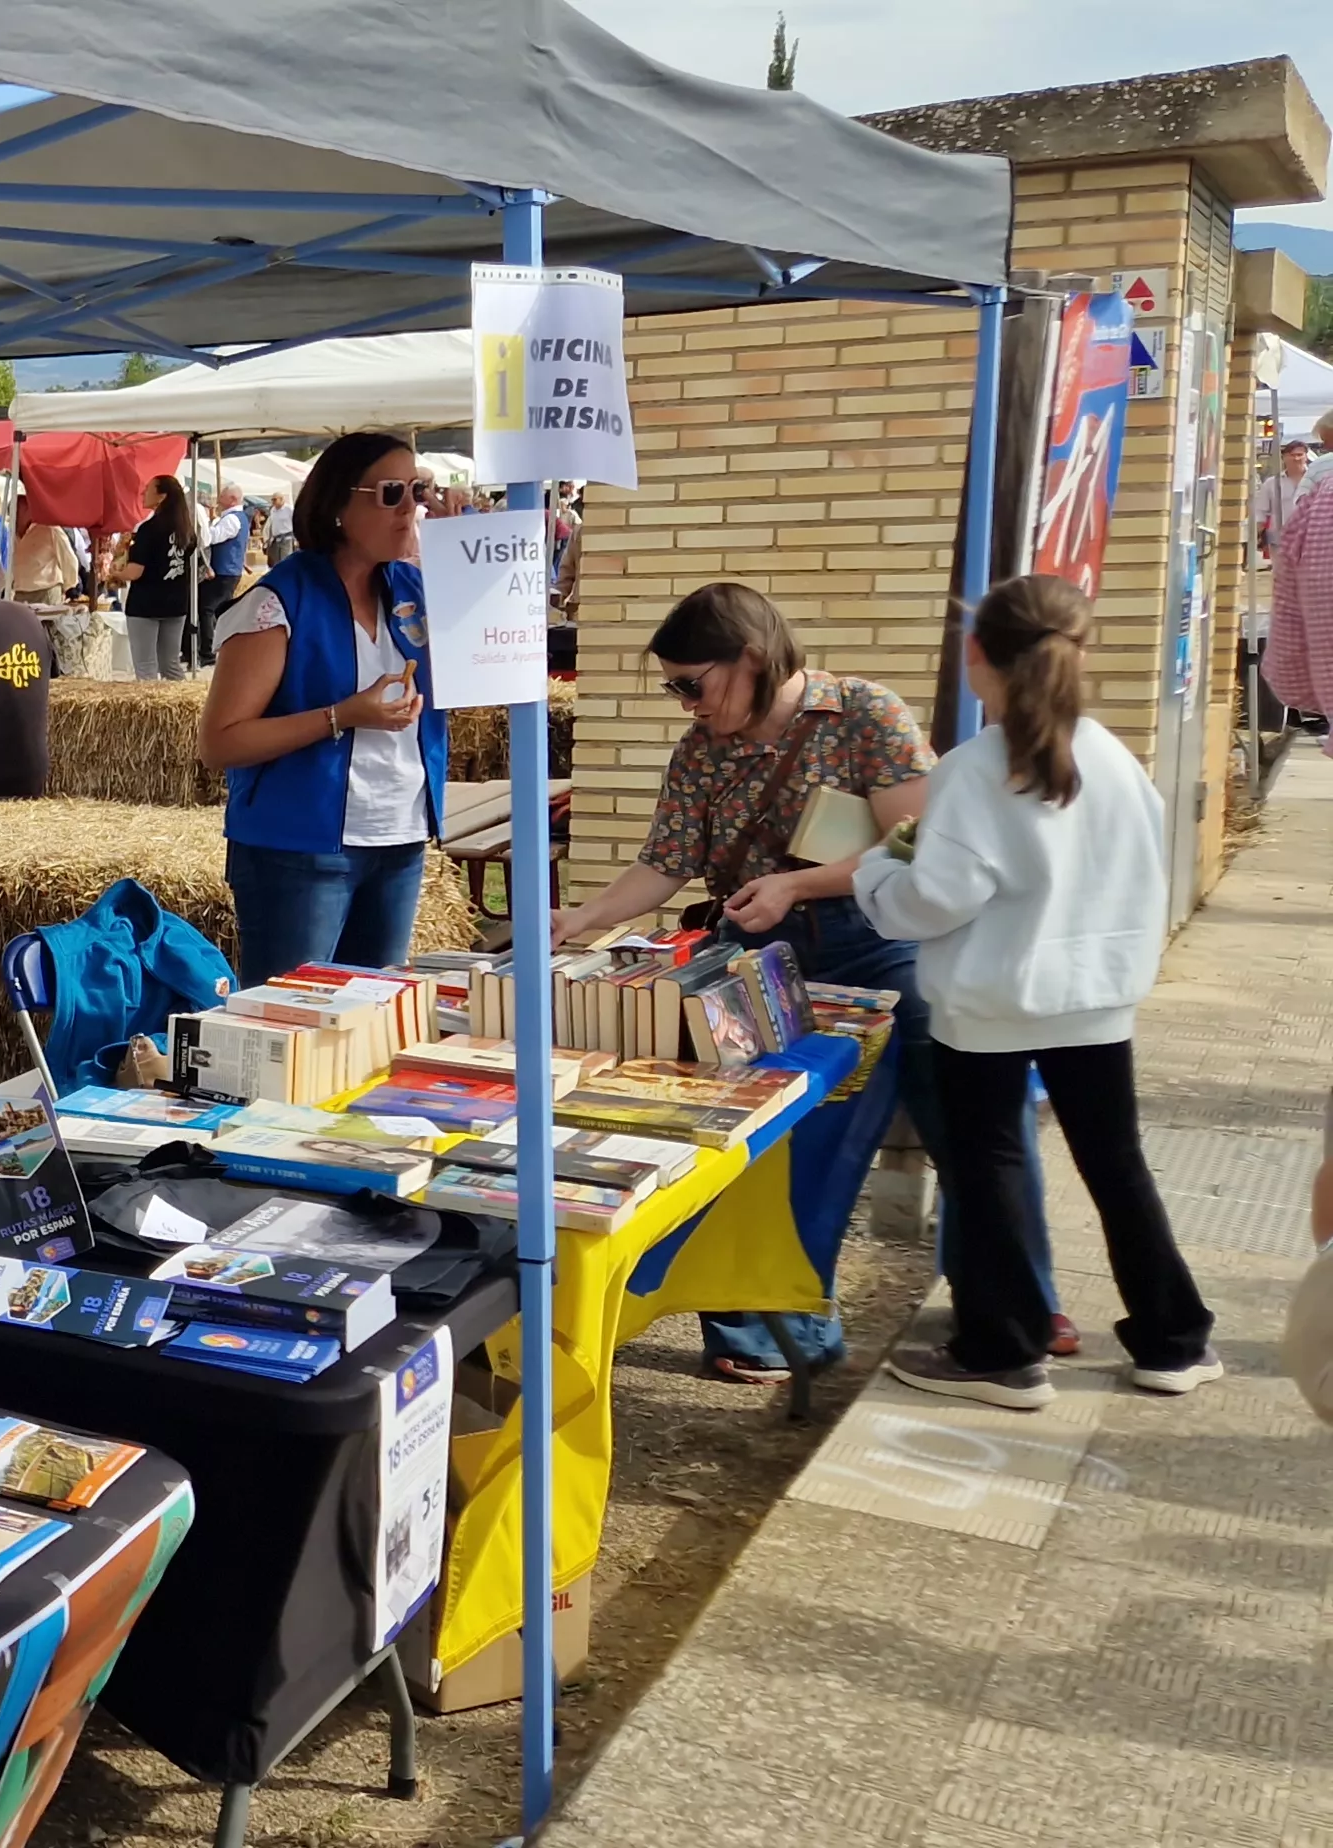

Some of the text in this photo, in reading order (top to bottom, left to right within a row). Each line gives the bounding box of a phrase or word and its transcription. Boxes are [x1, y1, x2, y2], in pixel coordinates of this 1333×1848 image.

[530, 338, 613, 369] OFICINA
[552, 378, 589, 398] DE
[528, 406, 623, 437] TURISMO
[460, 535, 539, 564] Visita
[20, 1186, 52, 1212] 18
[0, 1201, 78, 1239] RUTAS MÁGICAS
[13, 1214, 76, 1246] POR ESPAÑA
[211, 1226, 242, 1247] Feria
[282, 1271, 313, 1284] 18
[80, 1296, 103, 1315] 18
[92, 1279, 124, 1336] RUTAS MÁGICAS
[104, 1286, 132, 1332] POR ESPAÑA
